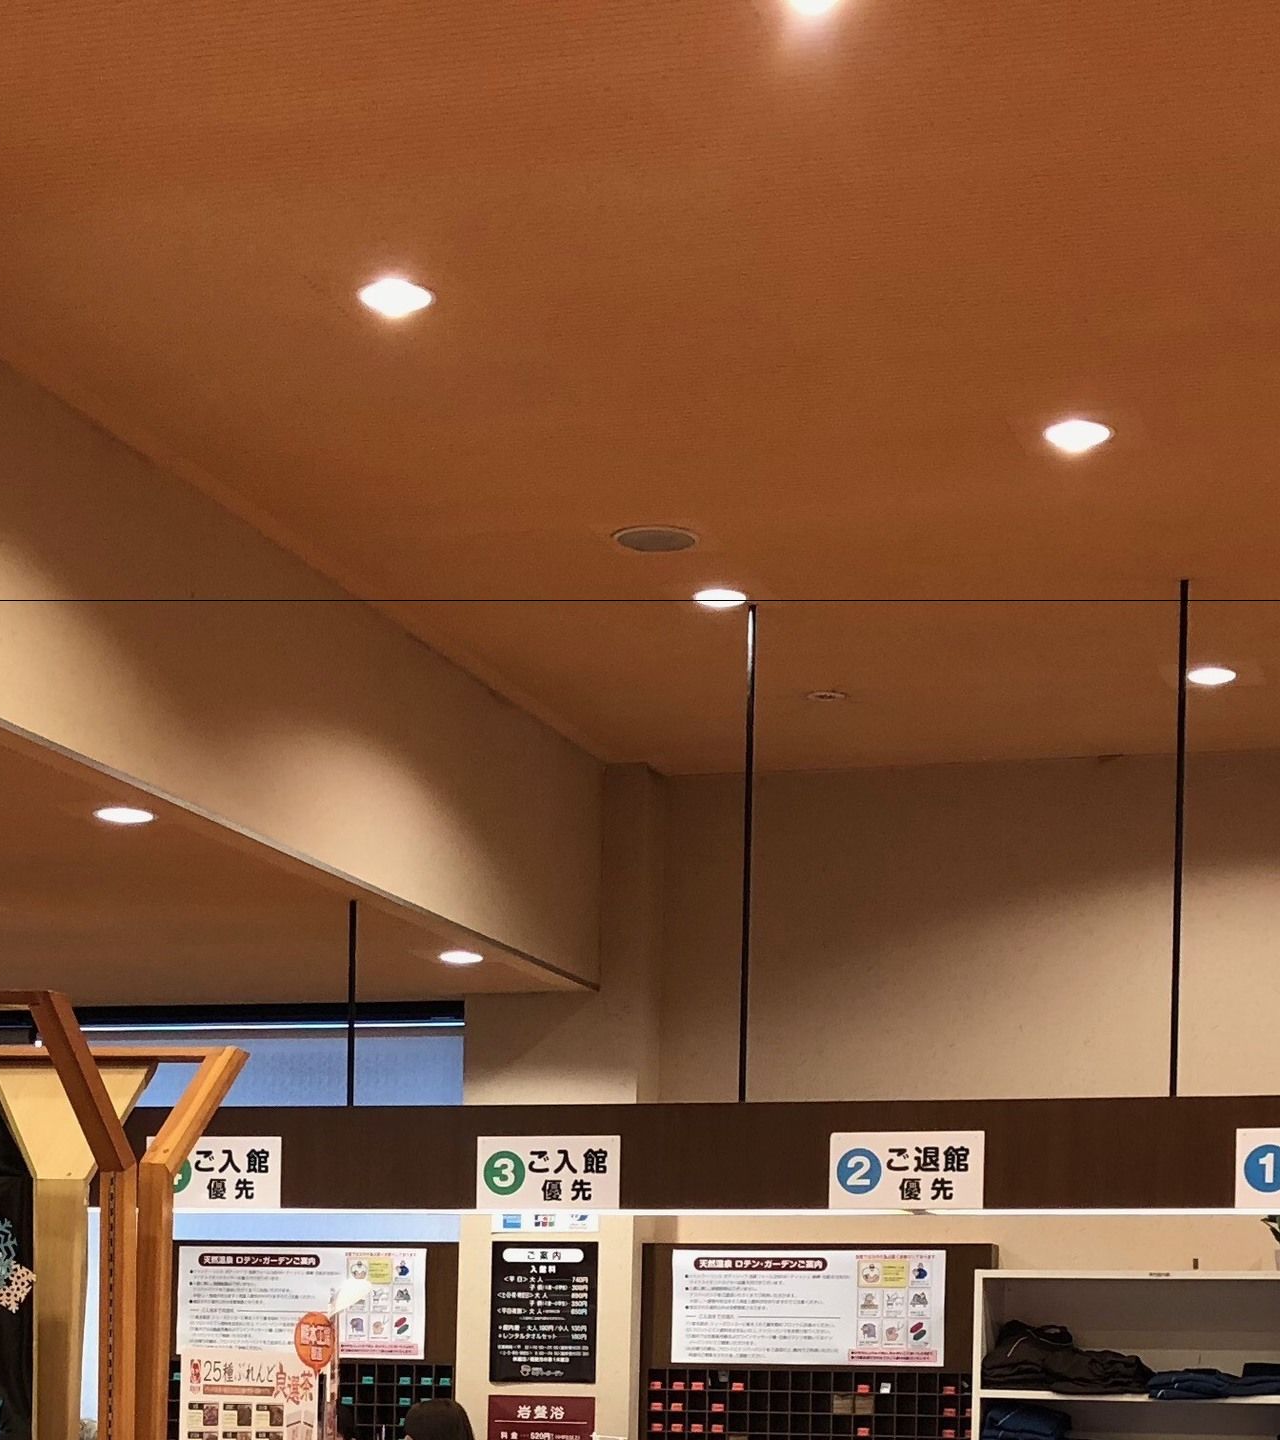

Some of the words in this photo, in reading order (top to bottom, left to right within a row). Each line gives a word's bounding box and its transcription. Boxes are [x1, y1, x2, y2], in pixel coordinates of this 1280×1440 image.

[194, 1148, 269, 1175] ご入館
[492, 1158, 516, 1188] 3
[528, 1148, 608, 1175] ご入館
[845, 1157, 872, 1187] 2
[885, 1146, 970, 1174] ご退館
[1258, 1153, 1277, 1183] 1
[206, 1178, 255, 1200] 優先
[541, 1178, 592, 1202] 優先
[899, 1177, 954, 1201] 優先
[527, 1250, 562, 1261] ご案内
[517, 1405, 565, 1420] 岩盤浴
